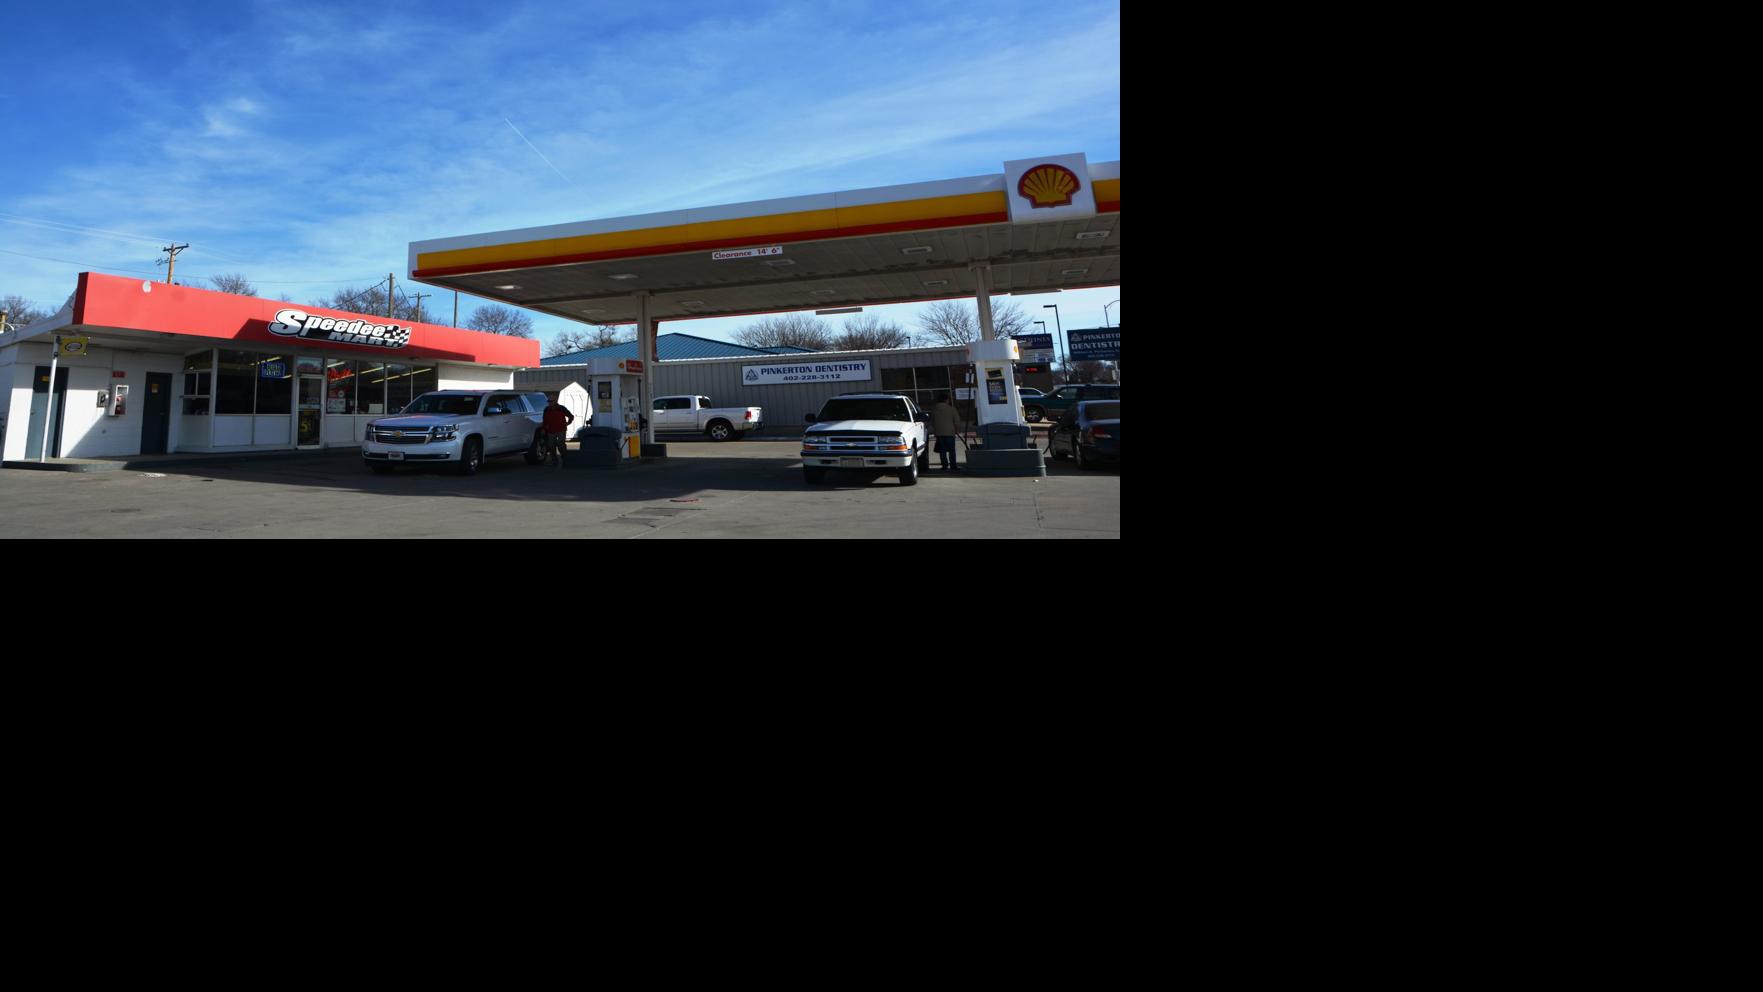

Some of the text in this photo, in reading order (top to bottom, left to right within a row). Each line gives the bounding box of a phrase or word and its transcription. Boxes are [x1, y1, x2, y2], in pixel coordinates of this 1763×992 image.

[714, 251, 752, 259] Clearance
[269, 309, 386, 337] Speedee
[328, 332, 402, 347] MART
[761, 363, 866, 375] PINKERTON DENTISTRY
[783, 373, 841, 381] 402-228-3112
